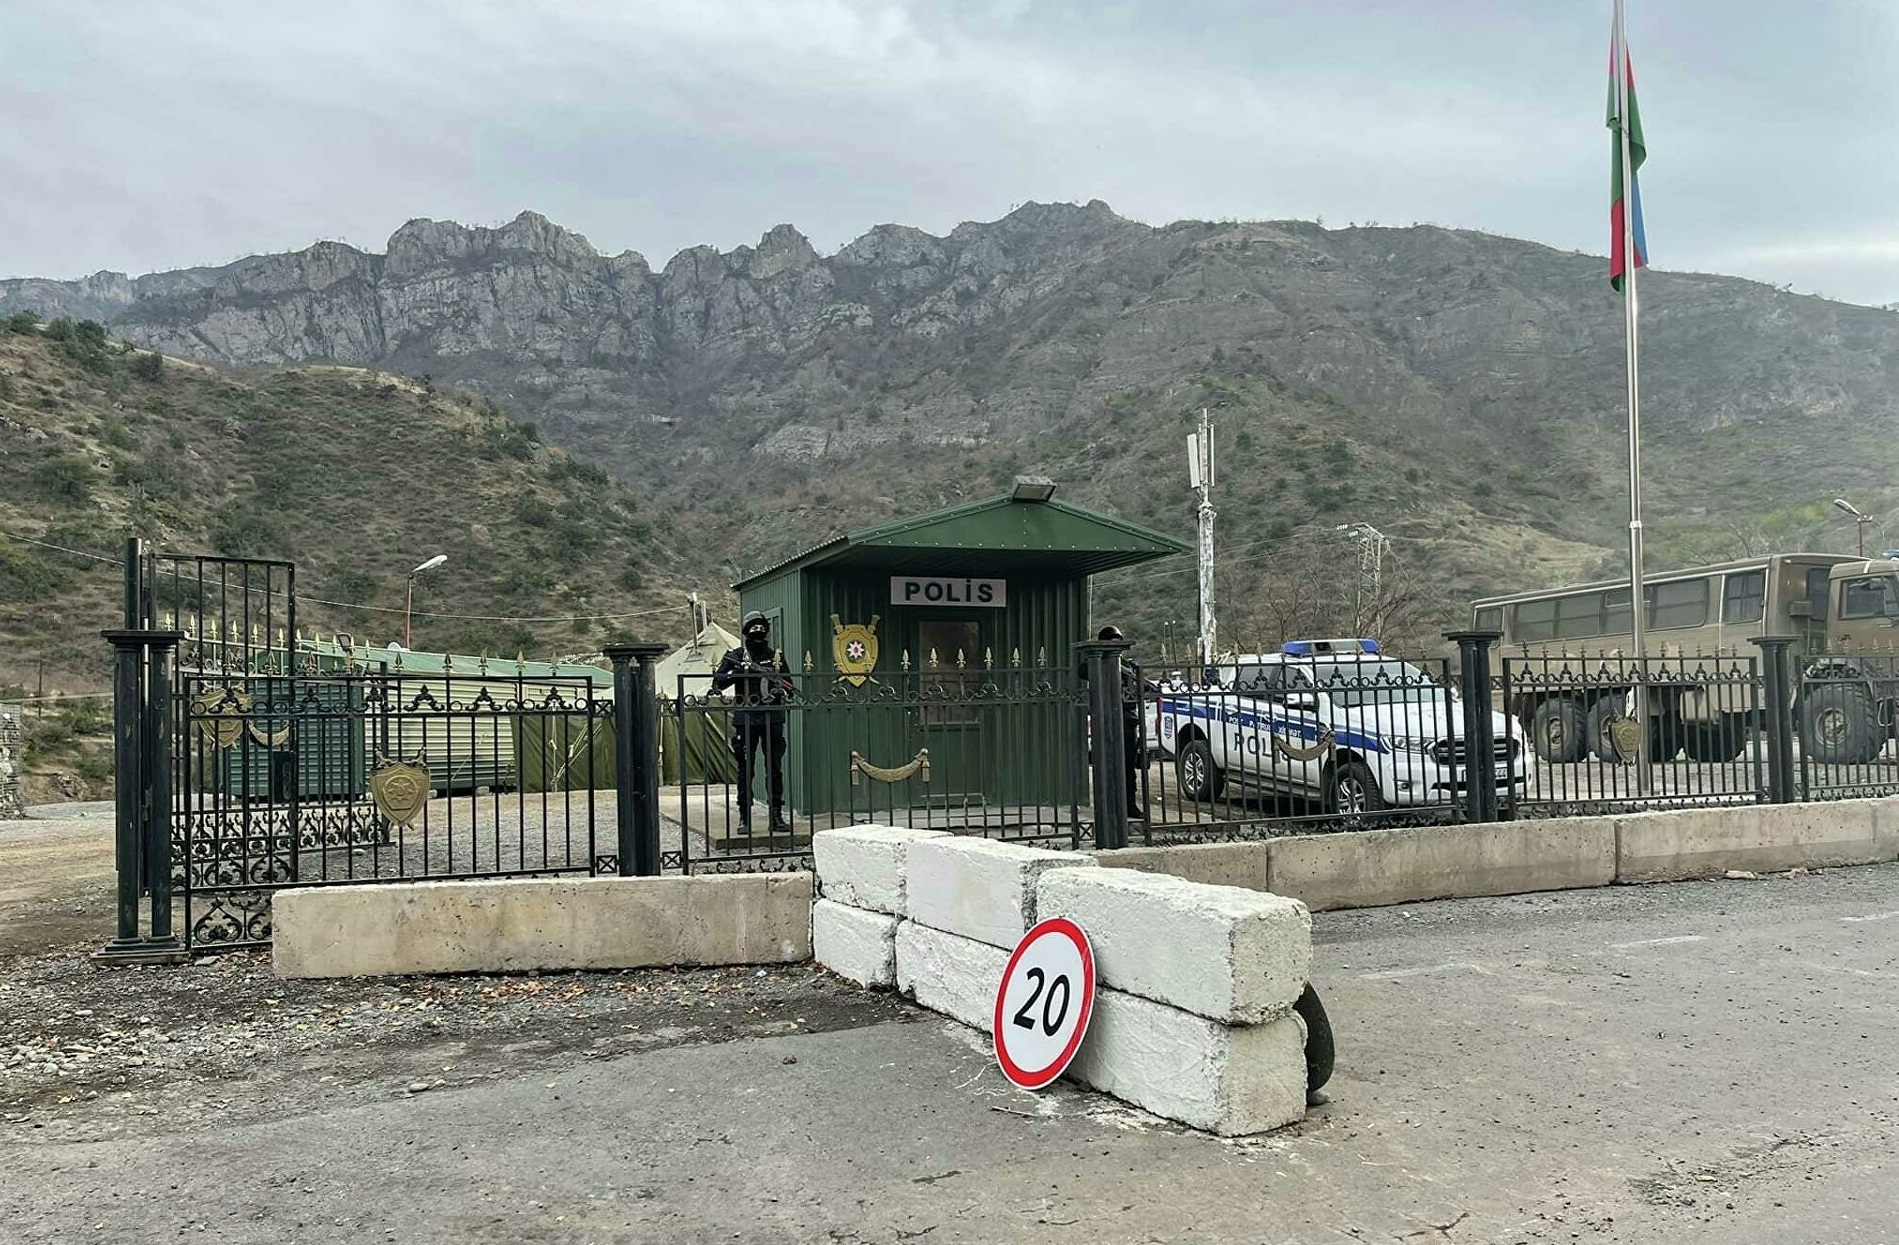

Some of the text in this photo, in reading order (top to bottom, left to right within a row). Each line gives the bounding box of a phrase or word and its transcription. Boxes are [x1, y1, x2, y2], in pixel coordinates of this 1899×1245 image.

[904, 578, 994, 603] POLİS
[1234, 732, 1292, 761] POL
[1013, 966, 1071, 1037] 20
